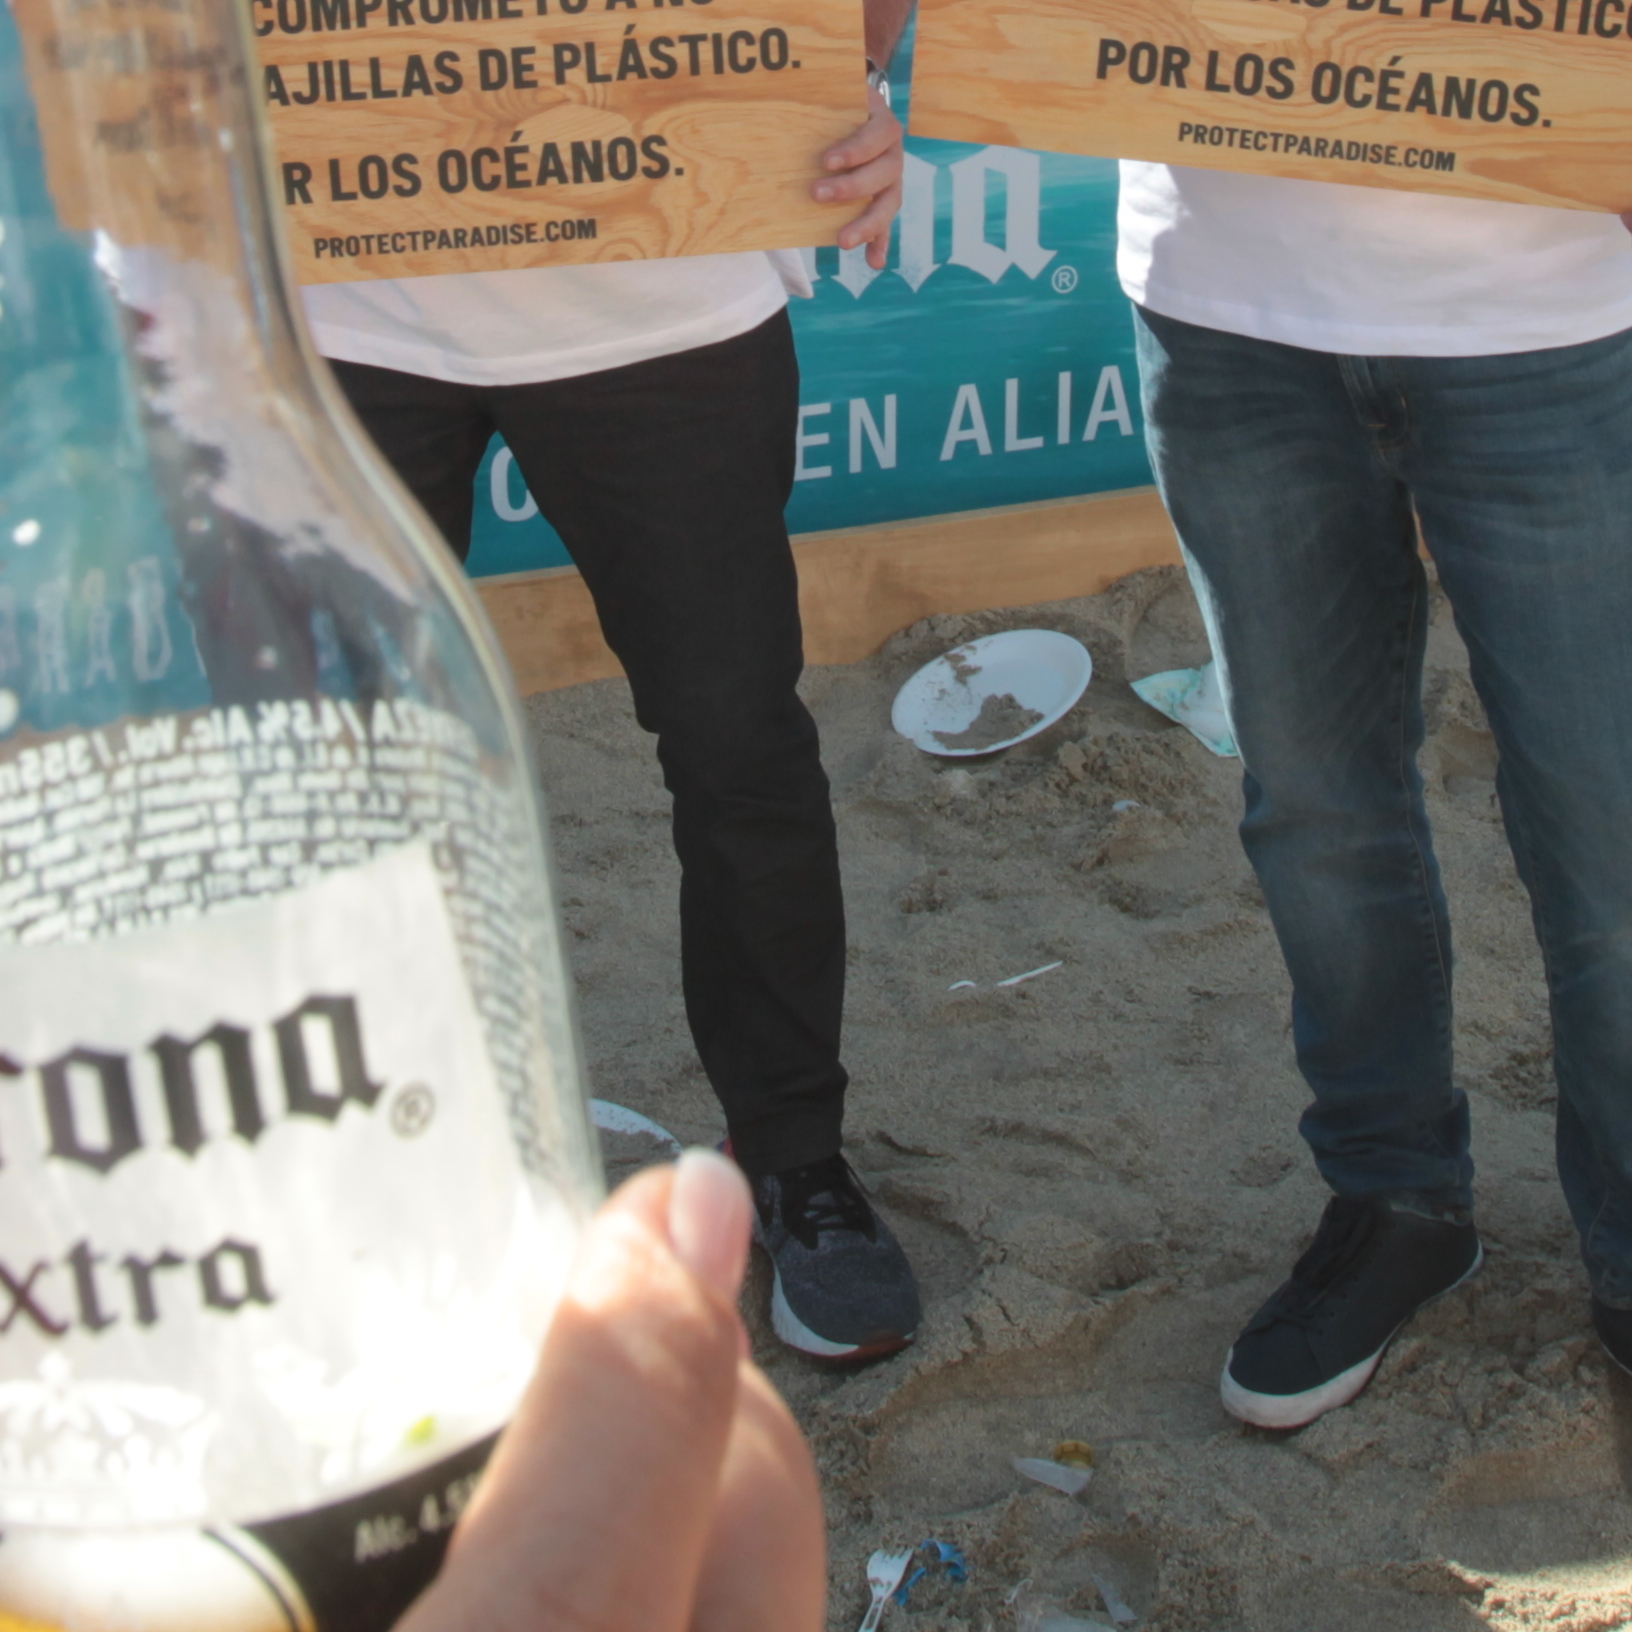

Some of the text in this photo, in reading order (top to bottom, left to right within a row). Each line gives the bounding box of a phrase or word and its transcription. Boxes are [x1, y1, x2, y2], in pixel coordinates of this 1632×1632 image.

[479, 45, 538, 94] DE
[553, 23, 804, 86] PLÁSTICO.
[1096, 37, 1555, 130] POR LOS OCÉANOS.
[329, 150, 423, 205] LOS
[436, 128, 686, 195] OCÉANOS.
[1177, 121, 1457, 174] PROTECTPARADISE.COM
[313, 218, 599, 260] PROTECTPARADISE.COM
